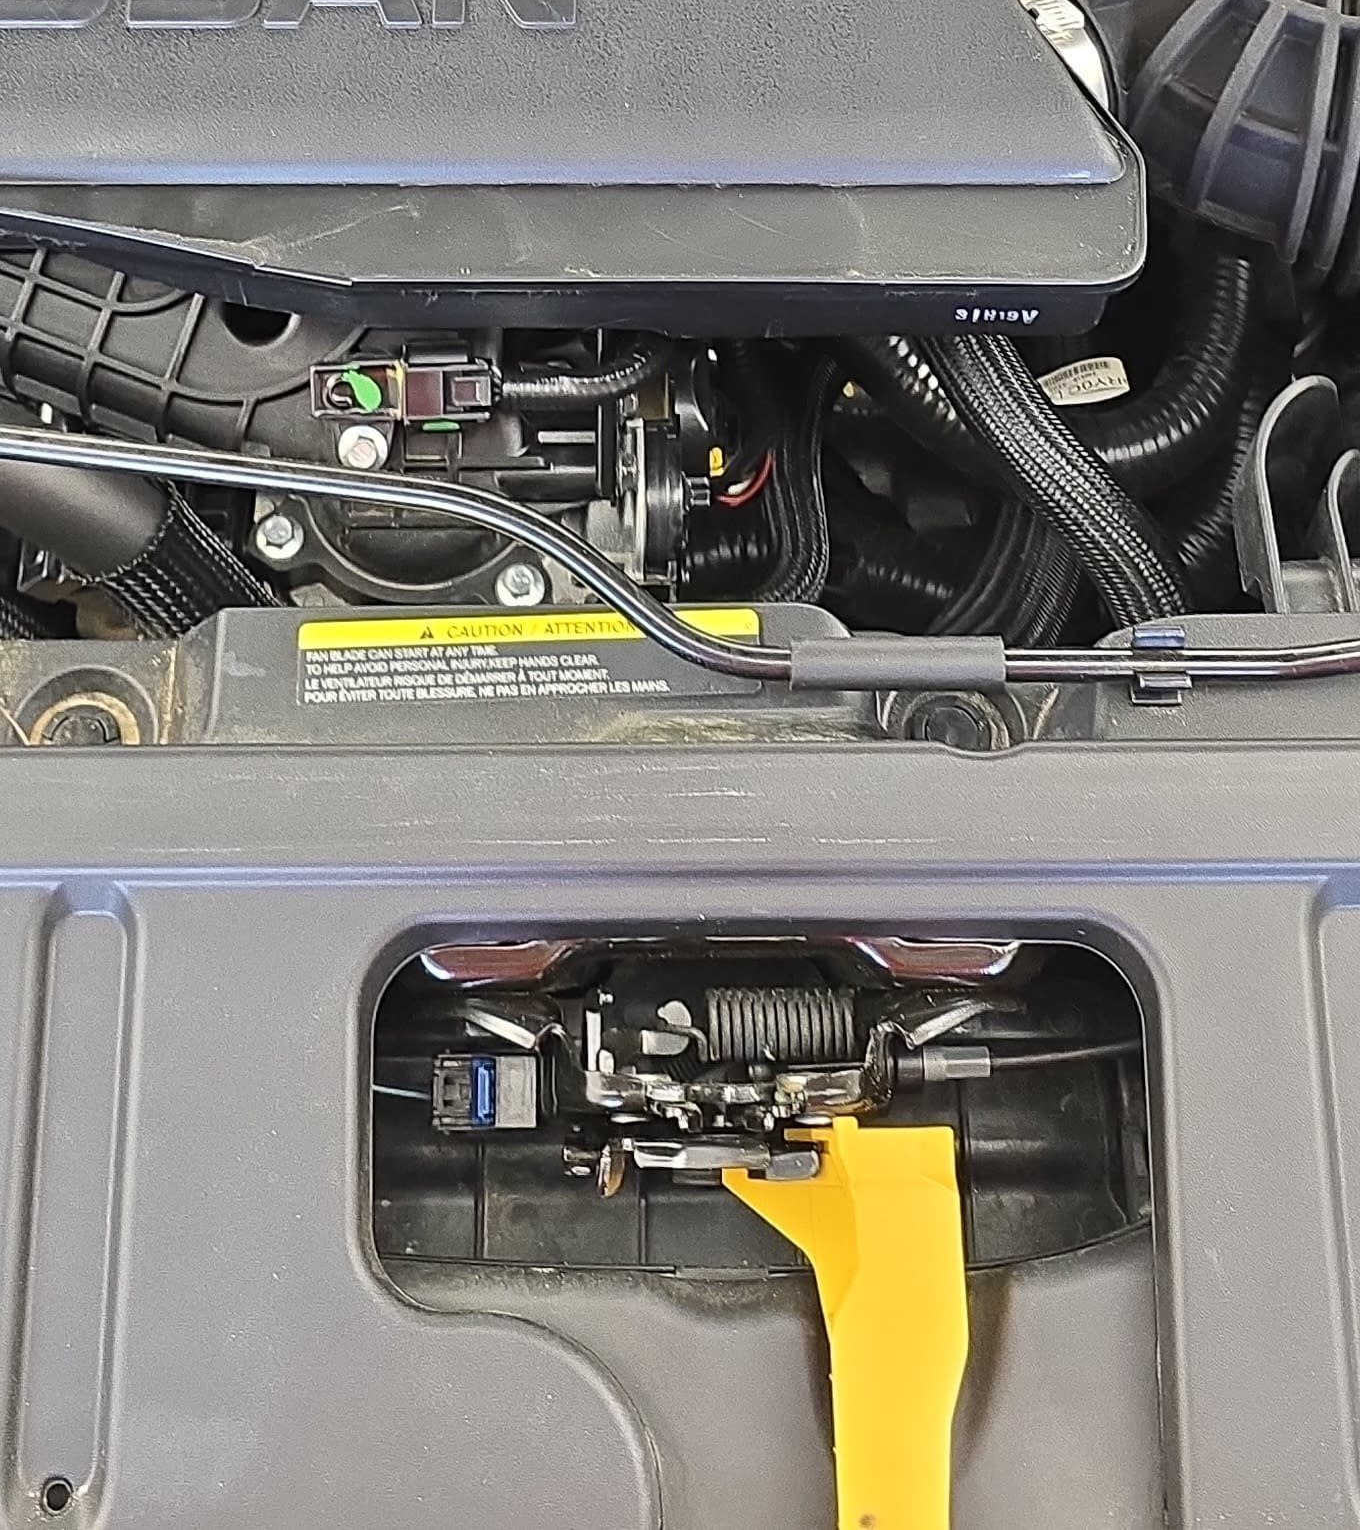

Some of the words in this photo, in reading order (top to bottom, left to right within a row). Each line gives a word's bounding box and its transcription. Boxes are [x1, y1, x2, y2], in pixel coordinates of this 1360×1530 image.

[447, 623, 523, 639] CAUTION
[305, 650, 329, 663] FAN
[330, 649, 367, 662] BLADE
[368, 648, 394, 660] CAN
[394, 646, 429, 659] START
[429, 646, 445, 658] AT
[445, 645, 470, 657] ANY
[305, 663, 322, 676] TO
[323, 662, 353, 675] HELP
[354, 661, 389, 674] AVOID
[389, 659, 449, 672] PERSONAL
[519, 655, 559, 668] HANDS
[304, 677, 320, 690] LE
[320, 675, 393, 689] VENTILATEUR
[393, 673, 436, 686] RISQUE
[437, 673, 455, 686] DE
[528, 669, 558, 682] TOUT
[304, 690, 337, 704] POUR
[378, 688, 415, 701] TOUTE
[478, 685, 496, 698] NE
[496, 684, 520, 697] PAS
[520, 683, 537, 696] EN
[537, 681, 609, 696] APPROCHER
[609, 681, 631, 693] LES
